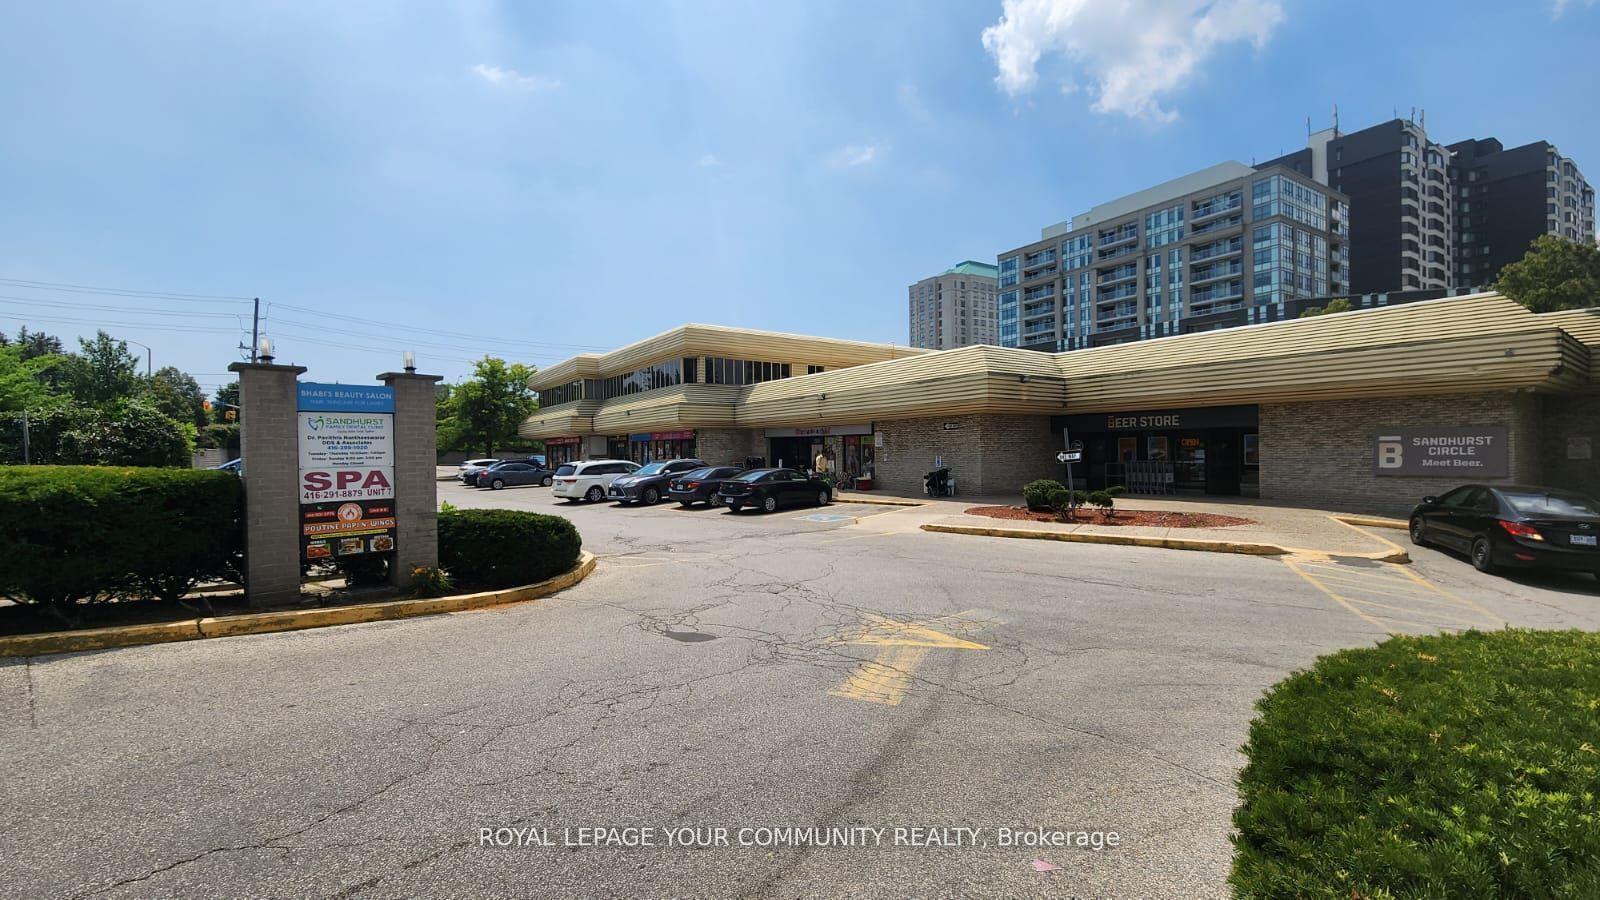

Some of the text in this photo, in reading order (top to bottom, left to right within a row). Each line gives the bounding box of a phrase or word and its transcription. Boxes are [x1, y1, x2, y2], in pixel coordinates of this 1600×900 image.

[334, 391, 363, 399] BEAUTY
[365, 392, 392, 400] SALON
[1107, 415, 1180, 429] BEER STORE
[1412, 436, 1493, 446] SANDHURST
[1428, 446, 1476, 455] CIRCLE
[1422, 459, 1483, 467] Meet Beer.
[303, 470, 391, 492] SPA
[303, 488, 392, 500] 416-291-8879 UNIT 7
[305, 523, 340, 532] POUTINE
[370, 519, 394, 527] WINGS
